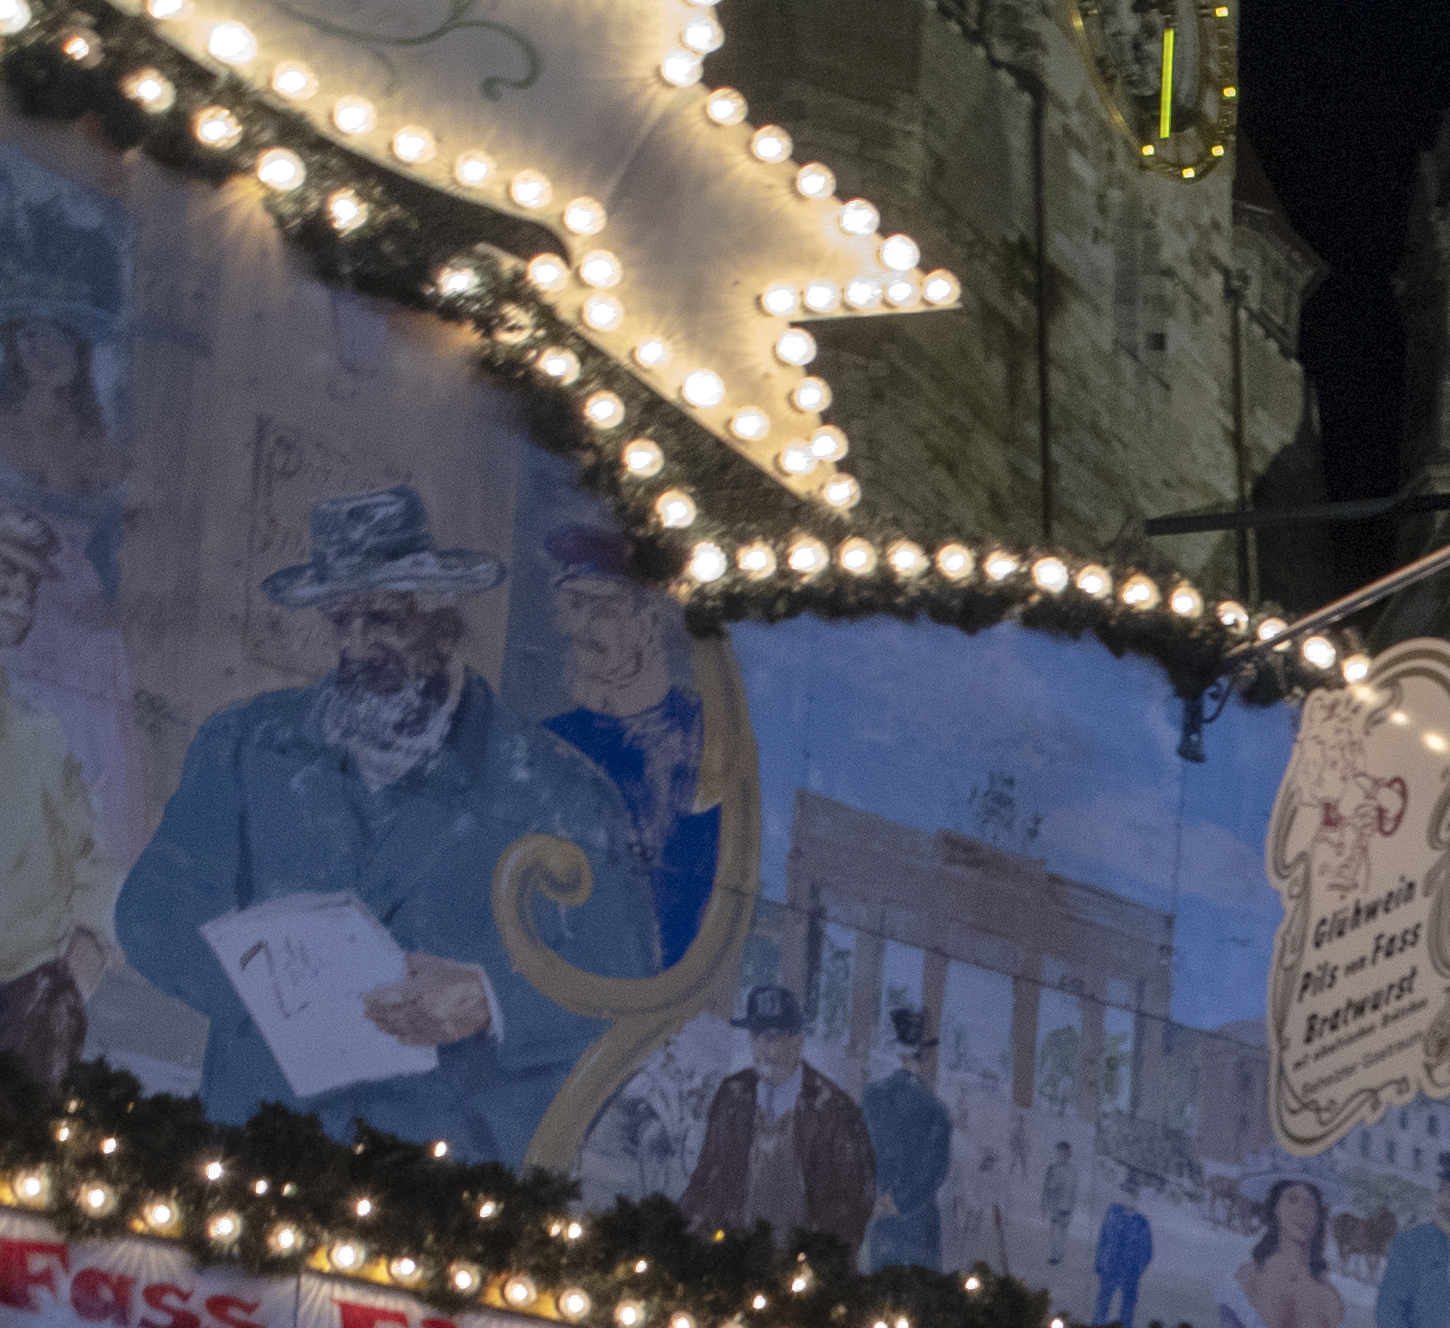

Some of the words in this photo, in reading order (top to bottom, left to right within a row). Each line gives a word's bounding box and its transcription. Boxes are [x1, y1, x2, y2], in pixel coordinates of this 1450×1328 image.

[1313, 876, 1416, 949] Glühwein
[1298, 960, 1339, 1002] Pils
[1371, 922, 1423, 966] Fass
[1303, 966, 1418, 1045] Bratwurst
